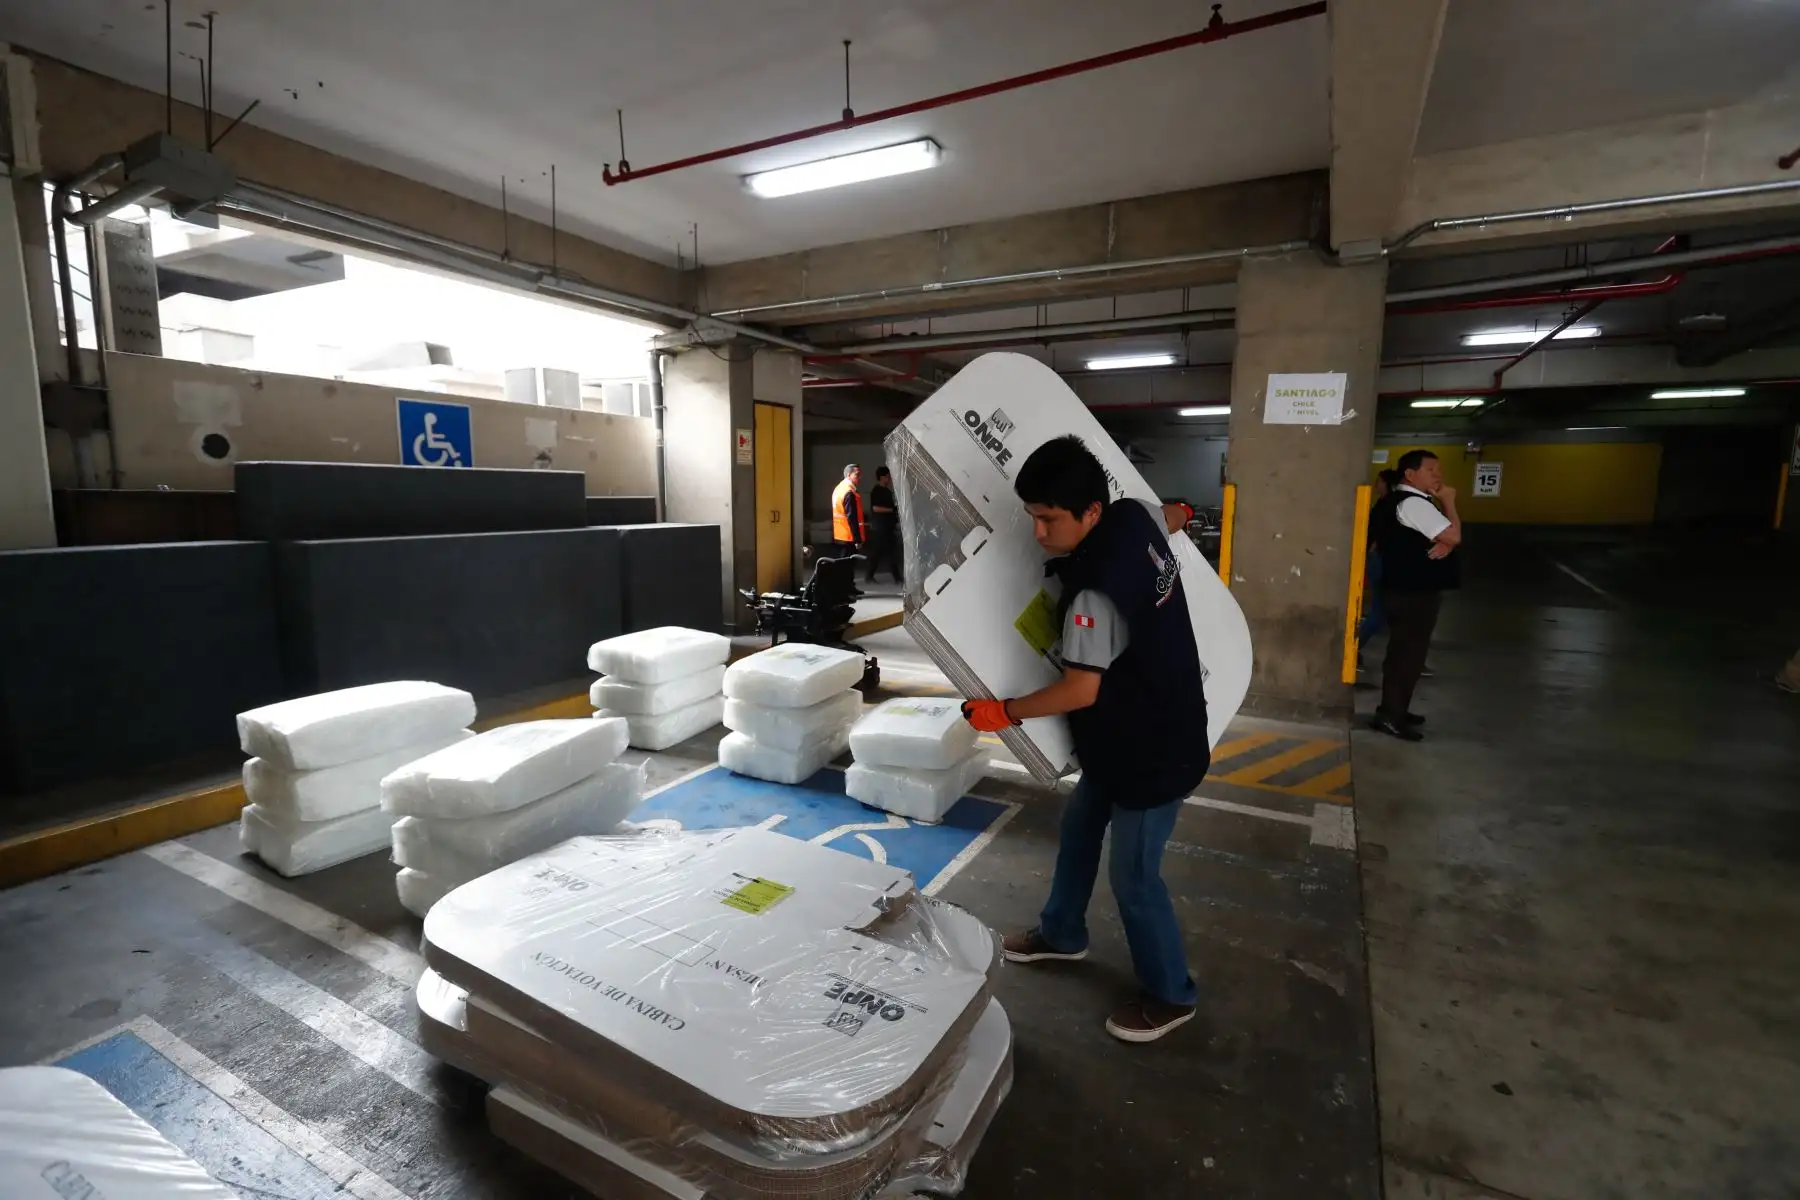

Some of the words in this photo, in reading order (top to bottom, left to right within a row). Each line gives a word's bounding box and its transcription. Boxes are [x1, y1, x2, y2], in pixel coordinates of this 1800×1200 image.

[1275, 388, 1337, 398] SANTIAGO
[965, 410, 1013, 467] ONPE
[1478, 474, 1497, 486] 15
[600, 985, 627, 1001] DE
[824, 981, 905, 1022] ONPE
[624, 996, 685, 1031] CABINA
